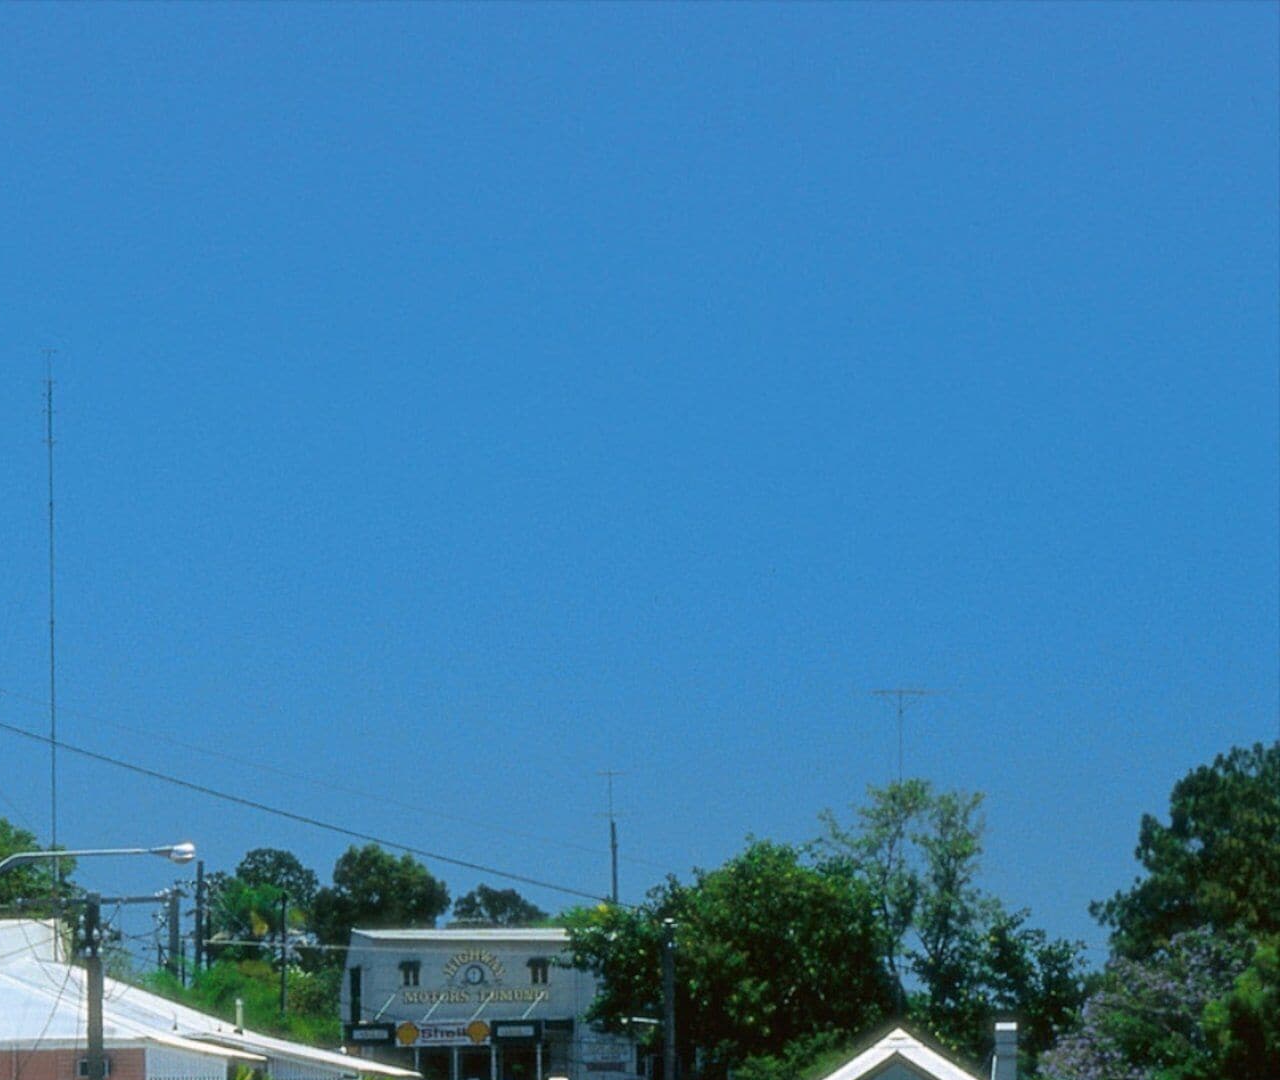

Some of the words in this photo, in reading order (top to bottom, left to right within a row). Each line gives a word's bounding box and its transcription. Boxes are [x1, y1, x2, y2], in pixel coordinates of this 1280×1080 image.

[443, 949, 506, 978] HIGHWAY
[403, 990, 469, 1004] MOTORS
[421, 1027, 464, 1039] Shell
